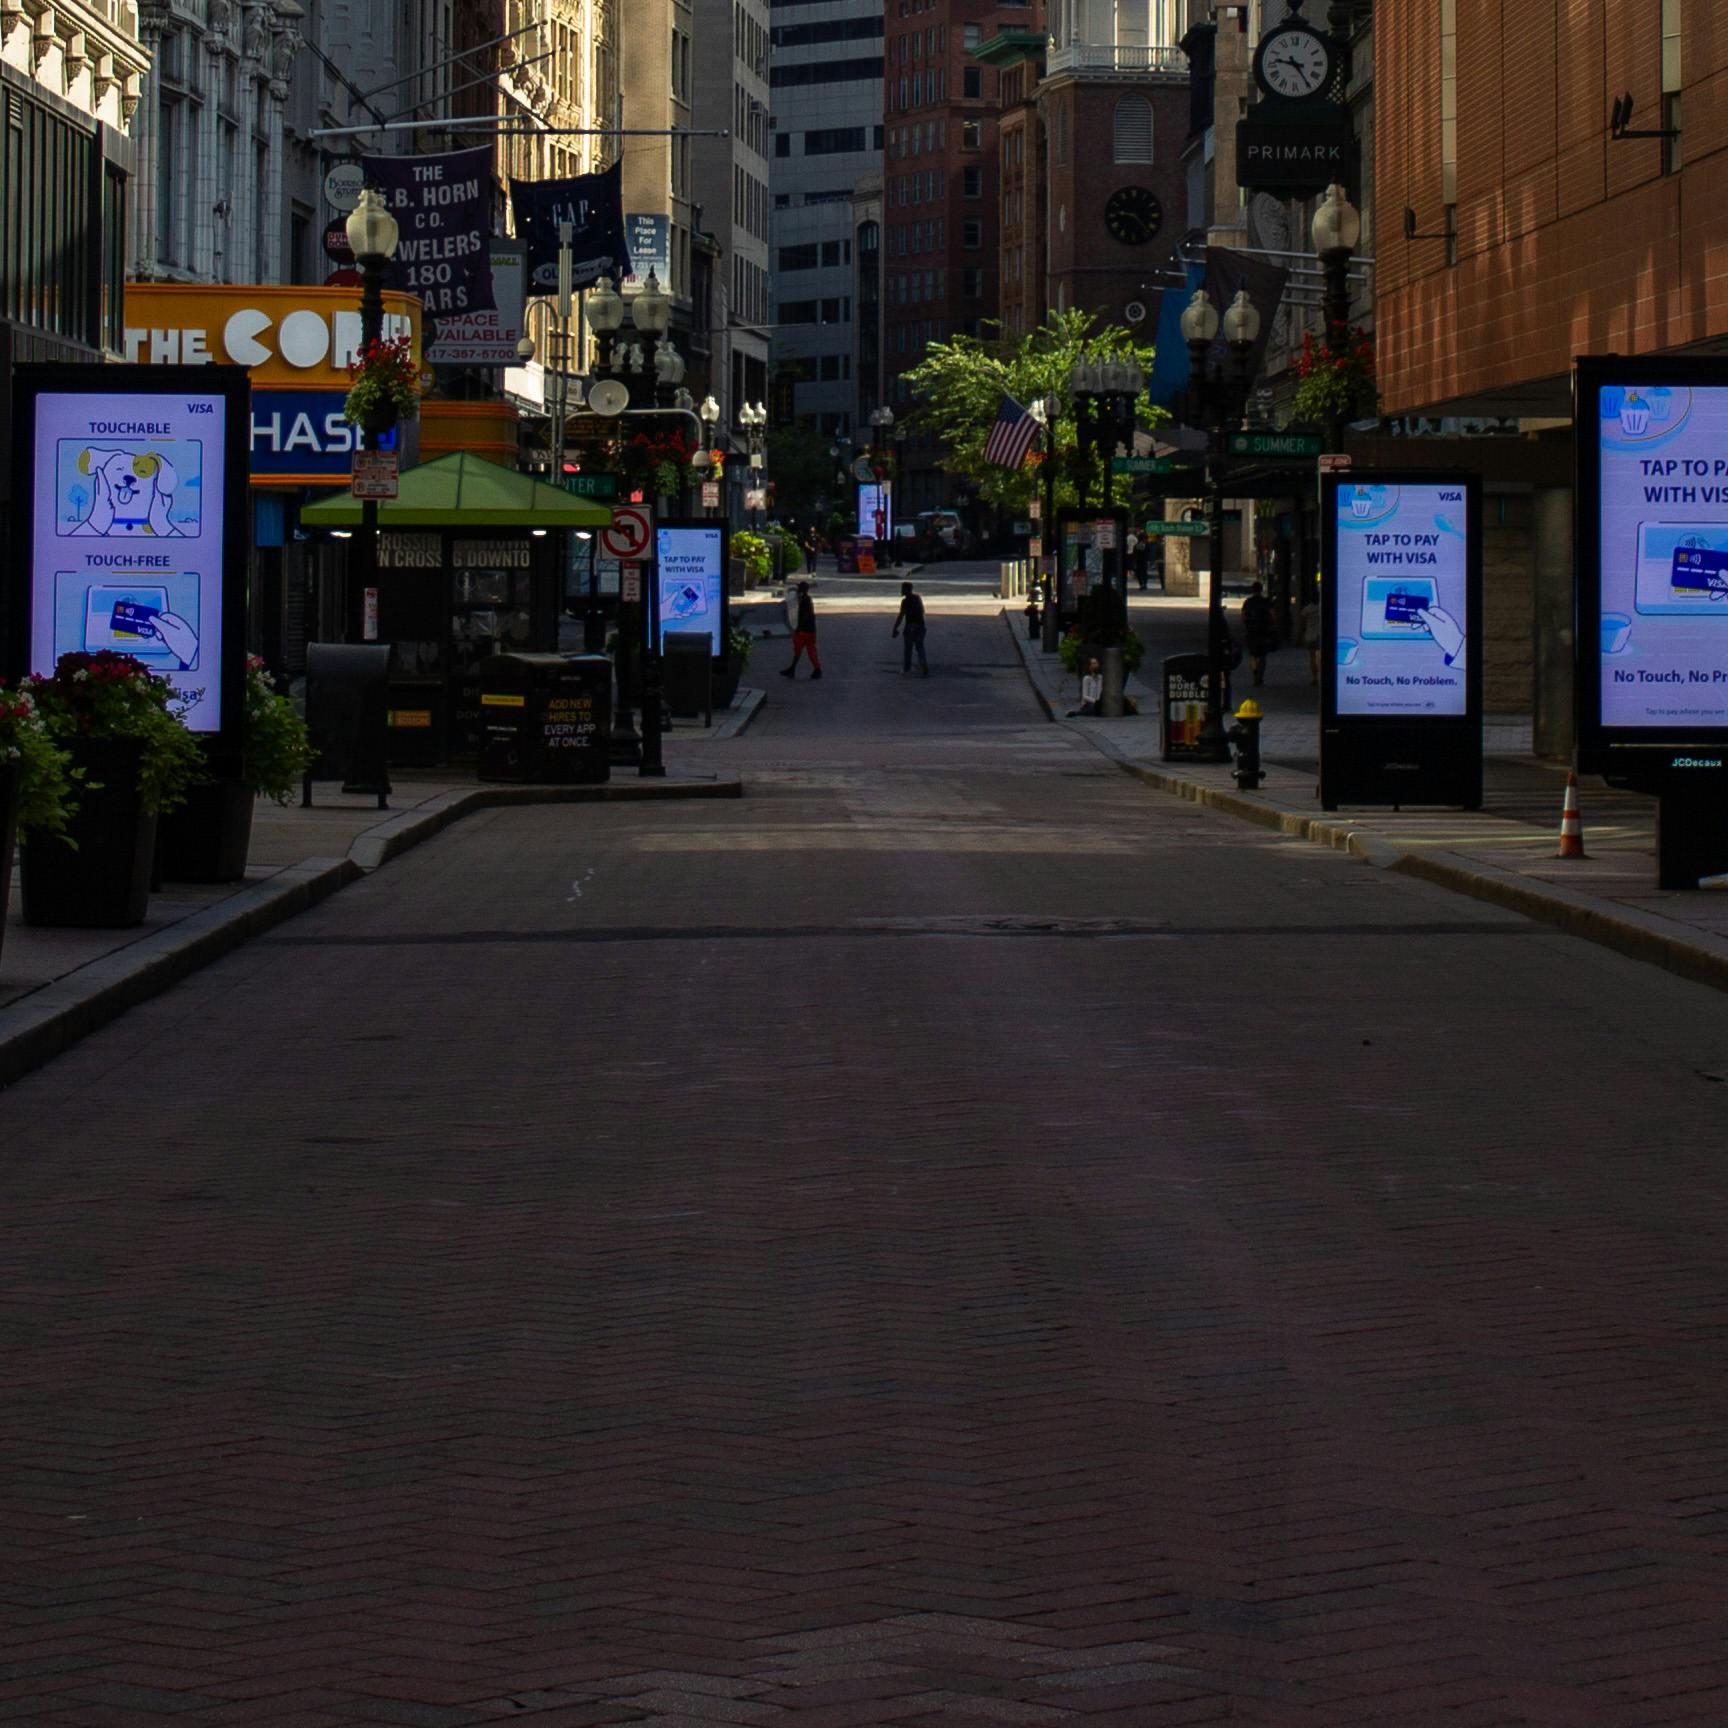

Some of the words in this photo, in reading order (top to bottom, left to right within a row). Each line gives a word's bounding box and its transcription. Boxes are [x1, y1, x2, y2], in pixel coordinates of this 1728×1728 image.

[1247, 145, 1341, 160] PRIMARK
[413, 165, 444, 182] THE
[423, 179, 479, 207] HORN
[638, 216, 654, 225] This
[634, 226, 657, 235] Place
[391, 230, 481, 262] WELERS
[638, 237, 653, 245] For
[633, 246, 657, 255] Lease
[407, 263, 452, 286] 180
[438, 314, 499, 326] SPACE
[123, 328, 214, 366] THE
[187, 403, 214, 414] VISA
[88, 422, 171, 434] TOUCHABLE
[1254, 437, 1305, 453] SUMMER
[1125, 459, 1157, 471] SUMMER
[1640, 459, 1679, 477] TAP
[1681, 459, 1709, 477] TO
[1438, 491, 1462, 502] VISA
[1643, 486, 1701, 504] WITH
[1365, 533, 1390, 547] TAP
[1392, 533, 1412, 547] TO
[1414, 533, 1440, 547] PAY
[85, 554, 171, 567] TOUCH-FREE
[467, 550, 530, 568] DOWNTO
[664, 555, 678, 563] TAP
[1367, 552, 1404, 565] WITH
[1406, 552, 1437, 565] VISA
[664, 566, 686, 574] WITH
[686, 566, 705, 574] VISA
[1346, 676, 1360, 685] No
[1361, 675, 1394, 687] Touch,
[1396, 676, 1411, 685] No
[1412, 675, 1458, 686] Problem.
[1614, 670, 1635, 684] No
[1637, 669, 1684, 685] Touch,
[1688, 670, 1709, 684] No
[549, 697, 569, 709] ADD
[569, 696, 593, 708] NEW
[548, 711, 577, 721] HIRES
[578, 712, 591, 721] TO
[544, 724, 575, 735] EVERY
[576, 724, 596, 734] APP
[548, 737, 560, 748] AT
[1671, 757, 1723, 768] JCDecaux
